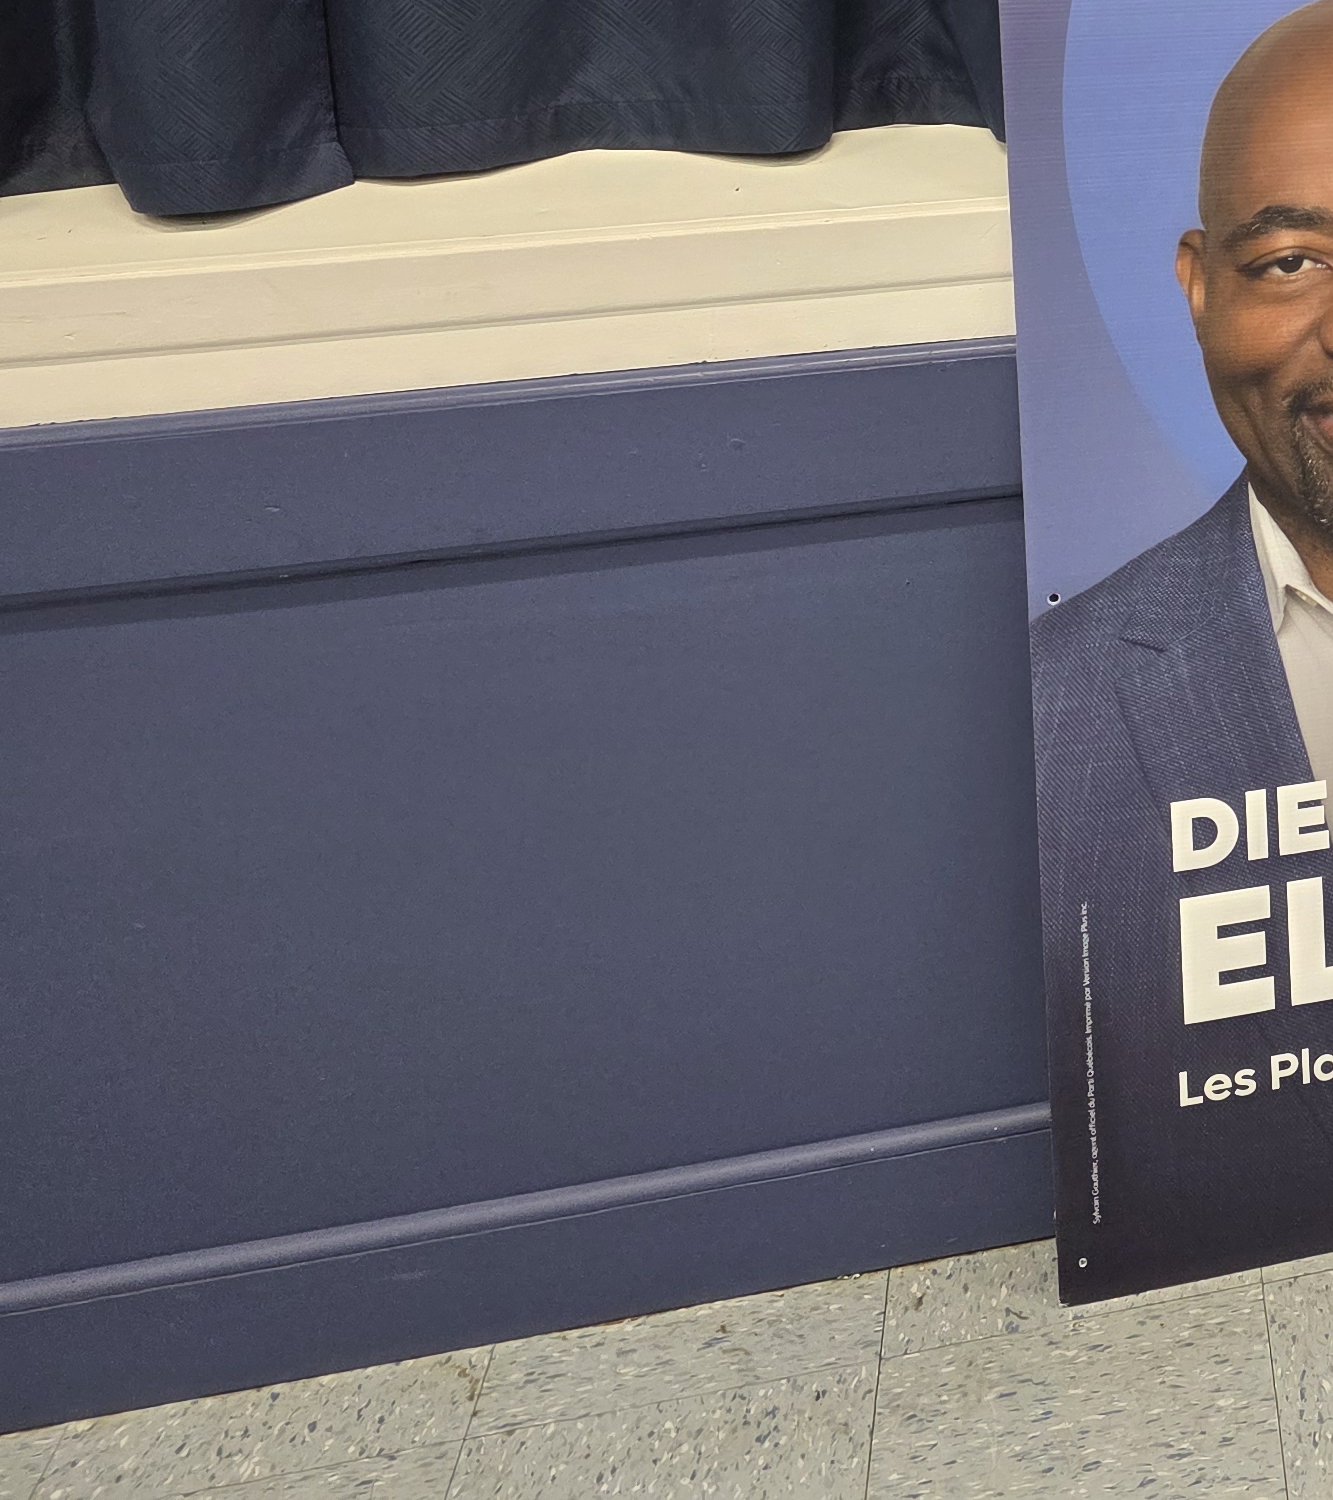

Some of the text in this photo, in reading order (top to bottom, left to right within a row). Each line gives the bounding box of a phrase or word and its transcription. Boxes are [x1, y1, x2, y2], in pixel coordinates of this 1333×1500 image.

[1083, 987, 1092, 1001] par
[1086, 1078, 1095, 1098] Parti
[1178, 1067, 1258, 1108] Les
[1087, 1097, 1096, 1109] du
[1087, 1109, 1097, 1136] officiel
